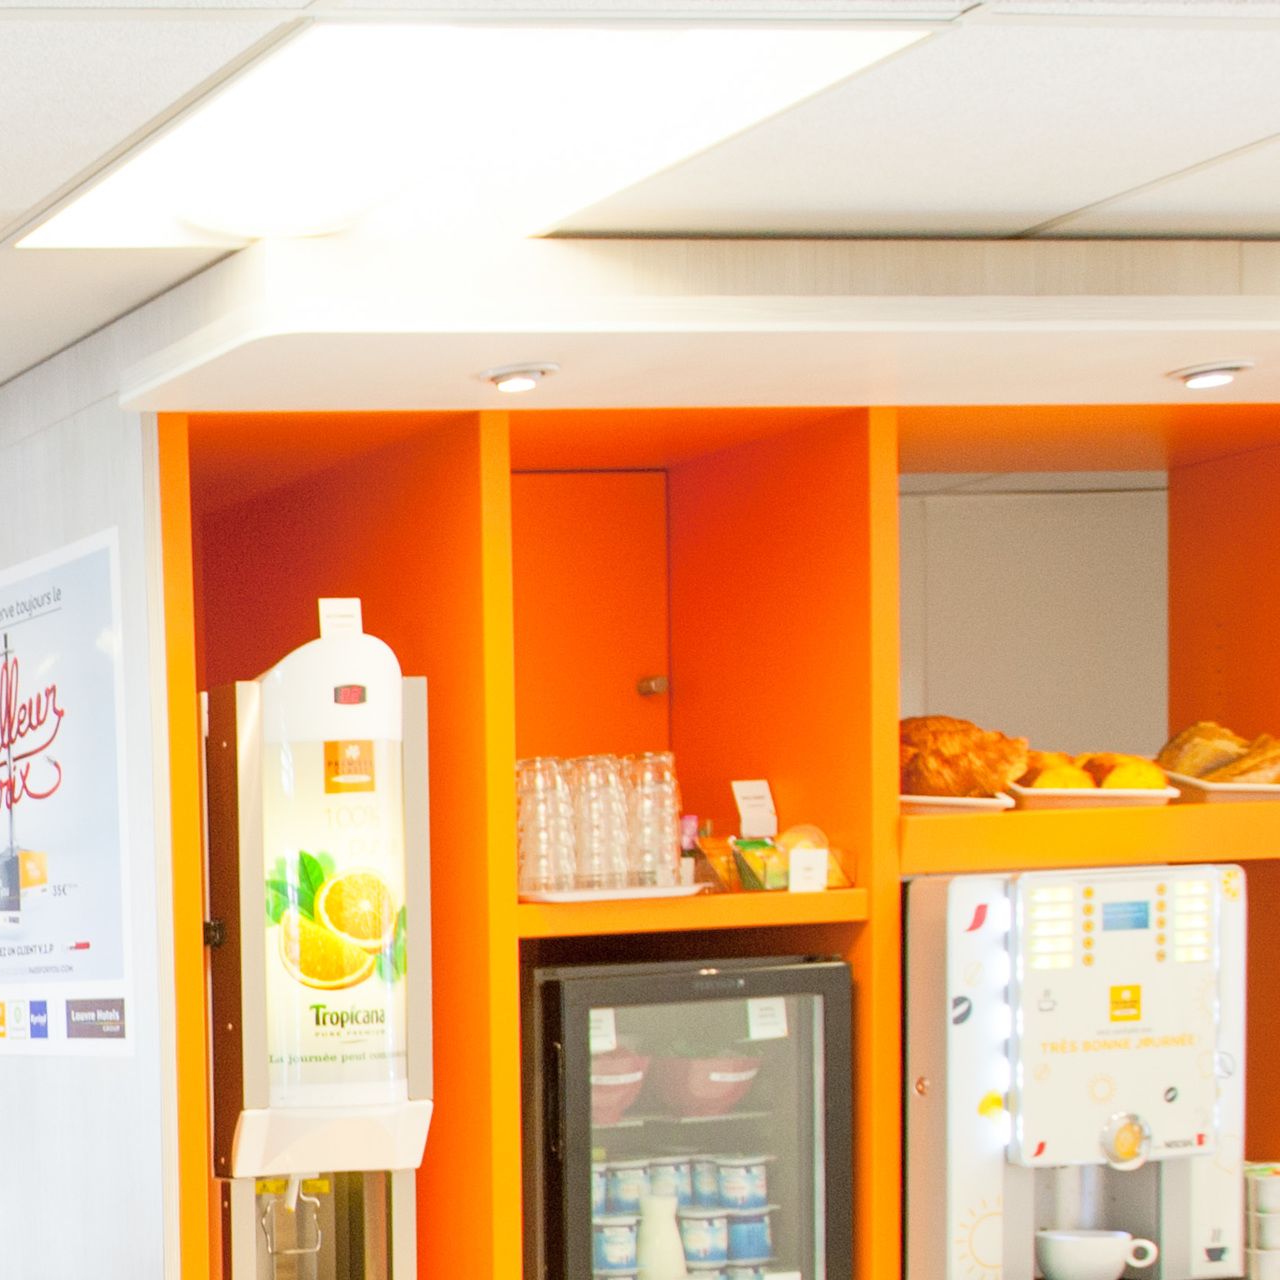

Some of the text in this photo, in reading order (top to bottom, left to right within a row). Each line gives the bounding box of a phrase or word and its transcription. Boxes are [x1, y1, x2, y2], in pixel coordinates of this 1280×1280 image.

[16, 590, 52, 616] toujours
[52, 586, 62, 602] le
[71, 1009, 96, 1023] Louvre
[308, 1003, 385, 1028] Tropicana
[269, 1053, 284, 1064] La
